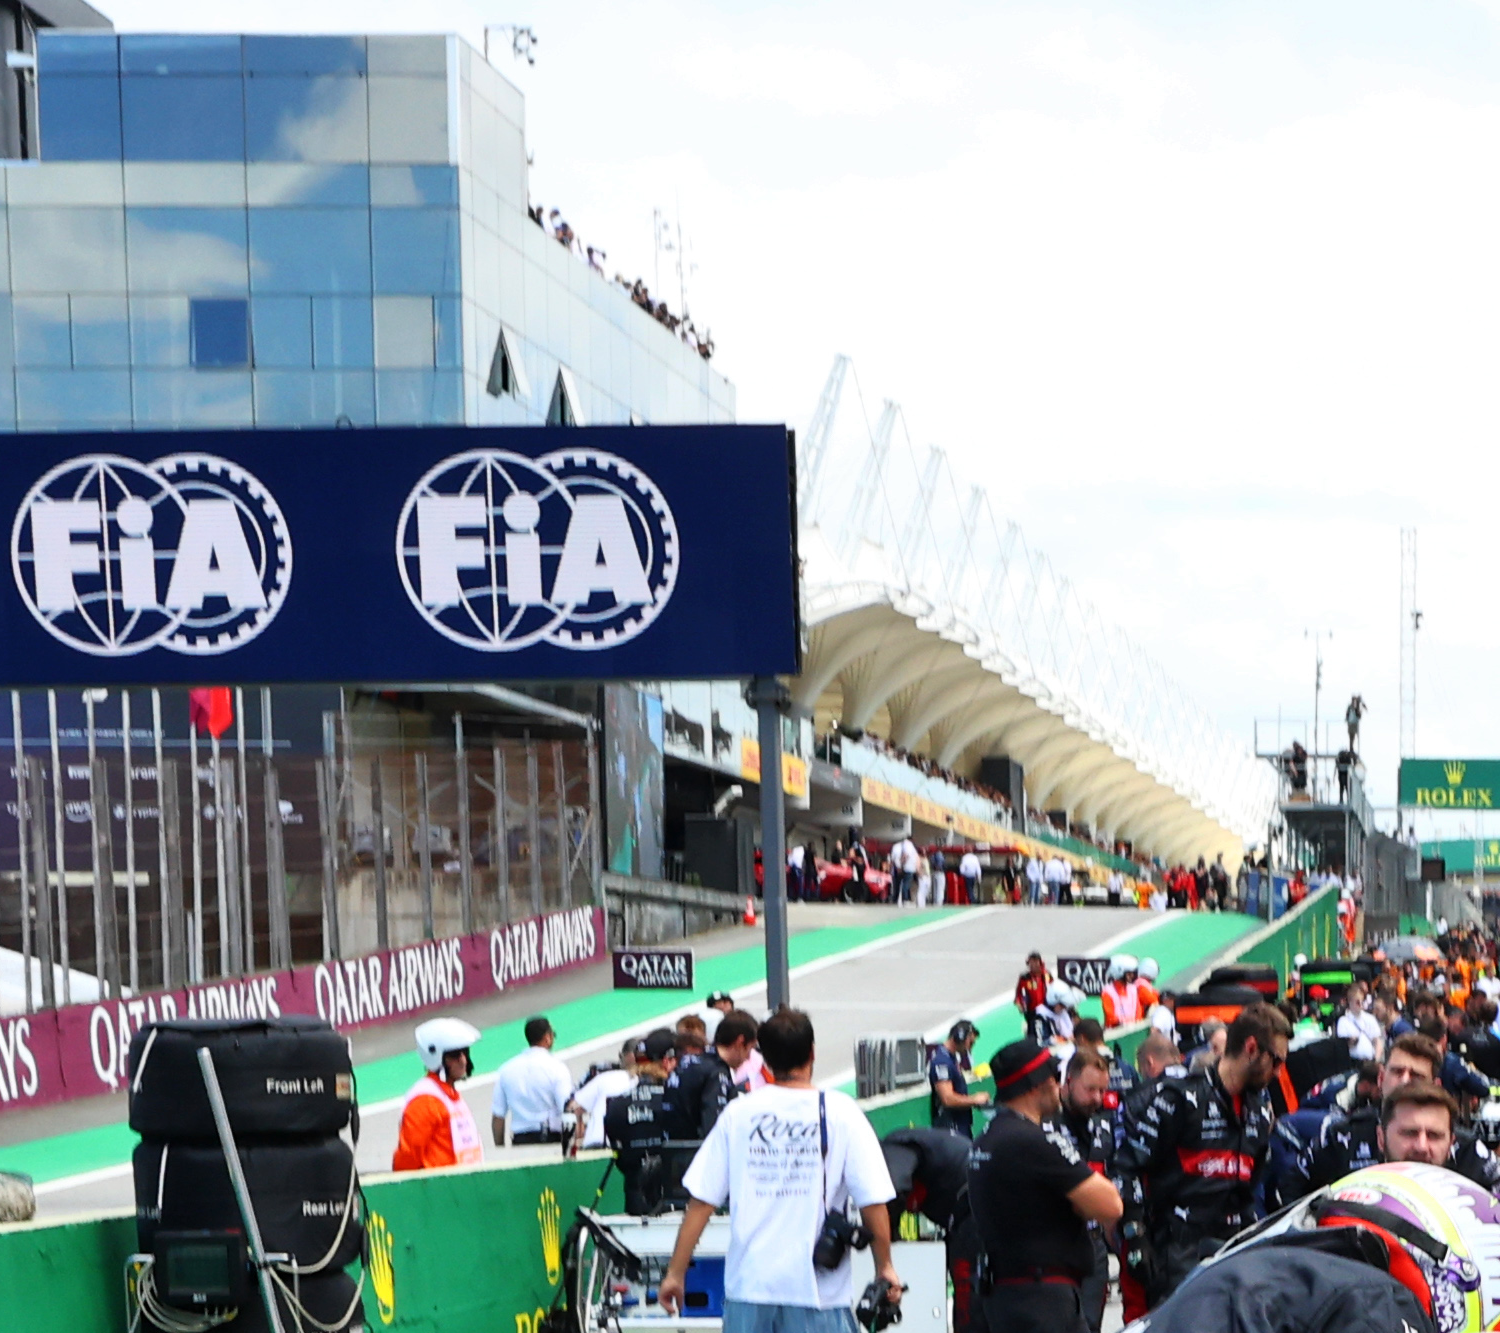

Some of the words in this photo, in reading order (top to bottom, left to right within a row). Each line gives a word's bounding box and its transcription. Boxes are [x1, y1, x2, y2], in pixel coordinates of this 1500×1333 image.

[1416, 787, 1492, 808] ROLEX
[490, 920, 540, 991] QATAR
[539, 904, 597, 970] AIRWAYS
[620, 953, 687, 977] QATAR
[314, 954, 388, 1030] QATAR
[387, 937, 466, 1016] AIRWAYS
[636, 972, 688, 987] AIRWAYS
[266, 1077, 301, 1097] Front
[303, 1076, 324, 1095] Left
[302, 1200, 328, 1218] Rear
